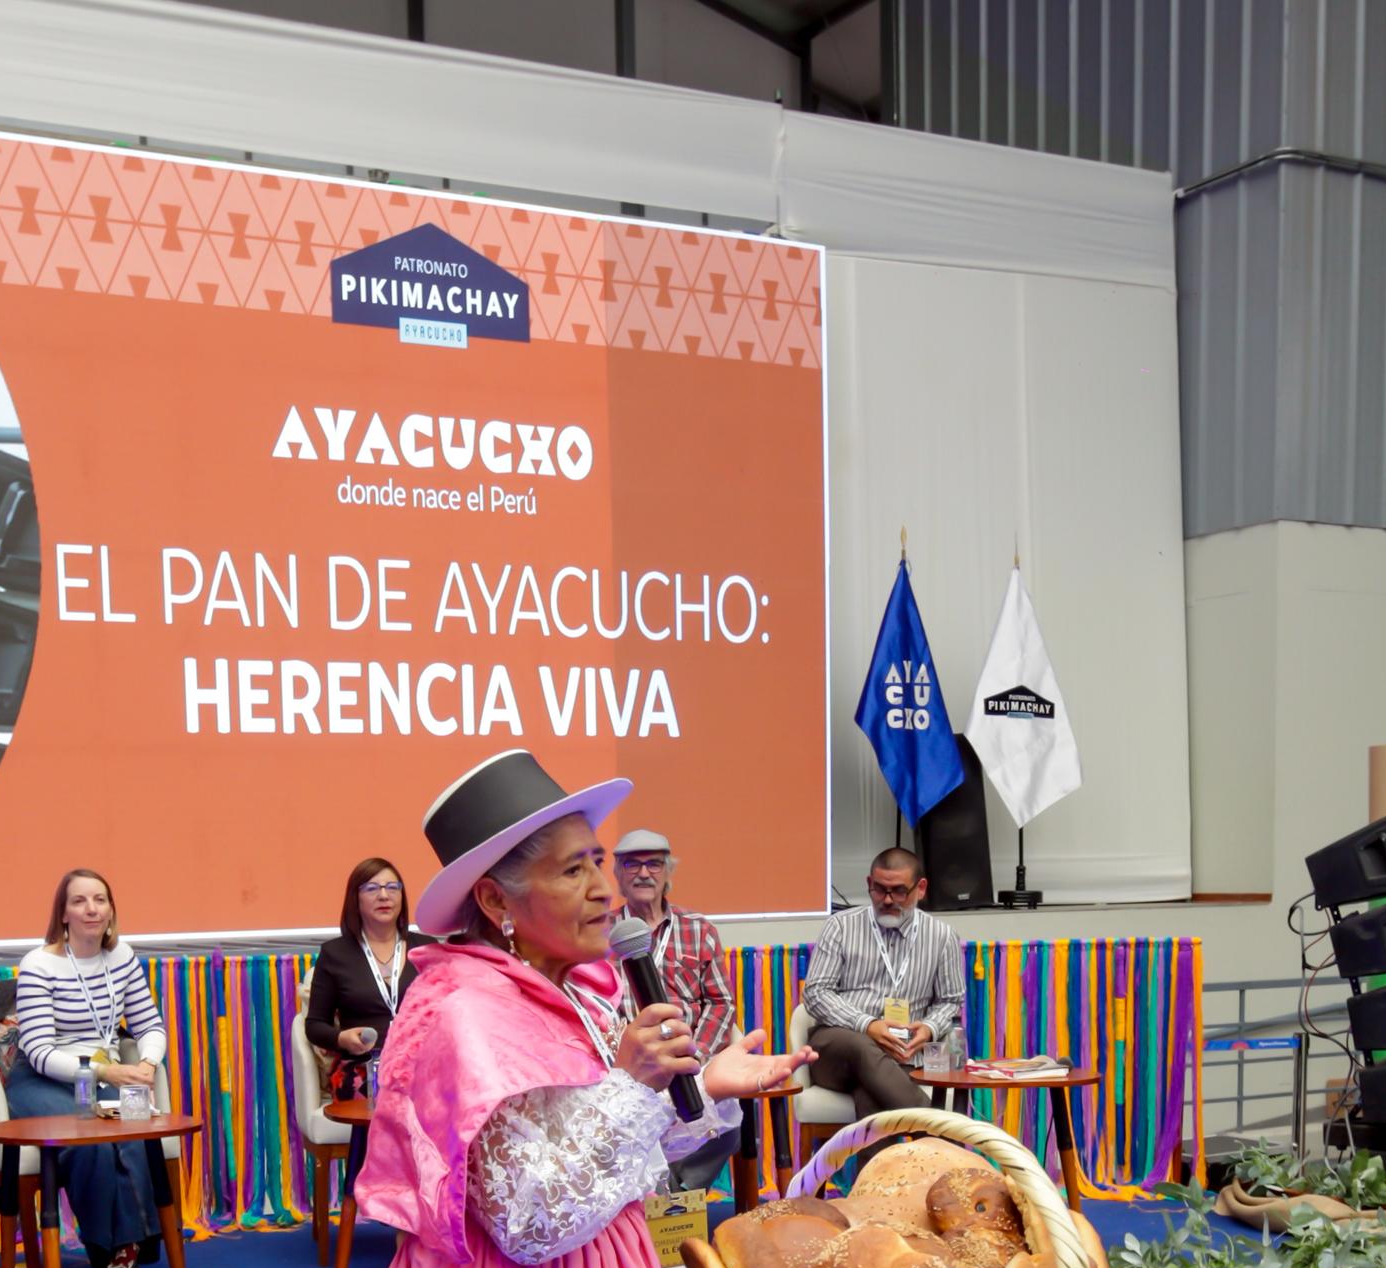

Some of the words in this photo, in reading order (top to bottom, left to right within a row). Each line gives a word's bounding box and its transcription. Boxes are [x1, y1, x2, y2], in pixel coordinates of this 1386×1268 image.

[394, 256, 469, 279] PATRONATO
[341, 274, 519, 320] PIKIMACHAY
[404, 323, 463, 343] AYACUCHO
[271, 404, 593, 481] AYACUCHO
[337, 475, 407, 507] donde
[412, 487, 462, 510] nace
[466, 484, 484, 511] el
[490, 486, 537, 515] Perú
[55, 543, 137, 623] EL
[161, 547, 299, 629] PAN
[327, 555, 413, 631] DE
[434, 561, 770, 644] AYACUCHO:
[183, 656, 524, 737] HERENCIA
[538, 665, 681, 738] VIVA
[988, 700, 1051, 715] PIKIMACHAY
